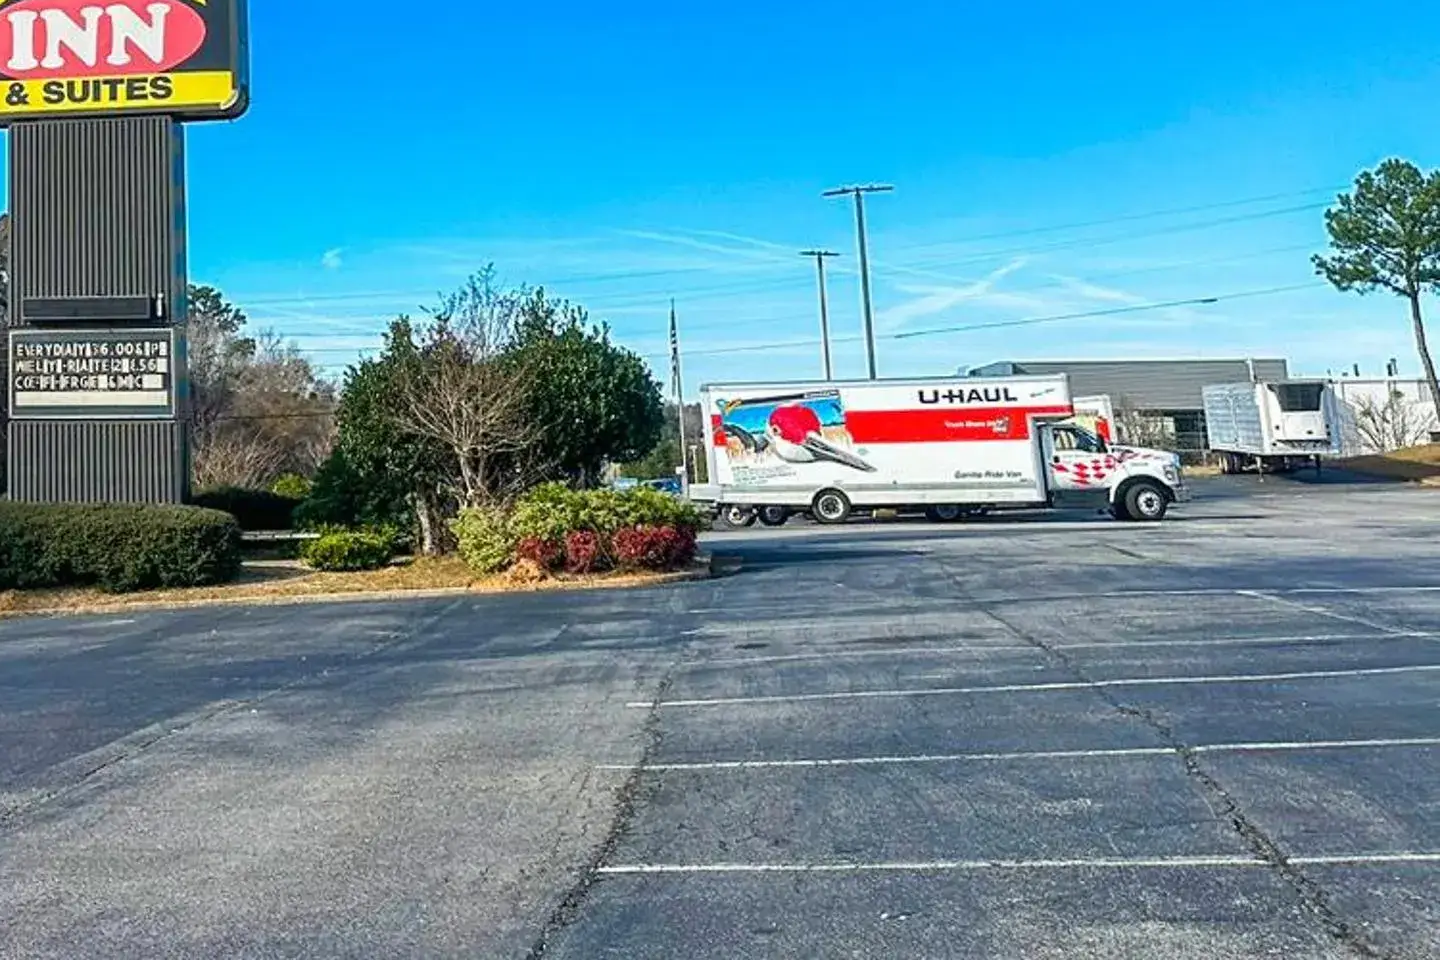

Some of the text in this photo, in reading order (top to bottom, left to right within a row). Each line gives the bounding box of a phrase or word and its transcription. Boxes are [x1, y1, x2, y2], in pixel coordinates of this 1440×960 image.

[7, 3, 171, 71] INN
[5, 76, 173, 106] & SUITES
[918, 387, 1018, 404] U-HAUL
